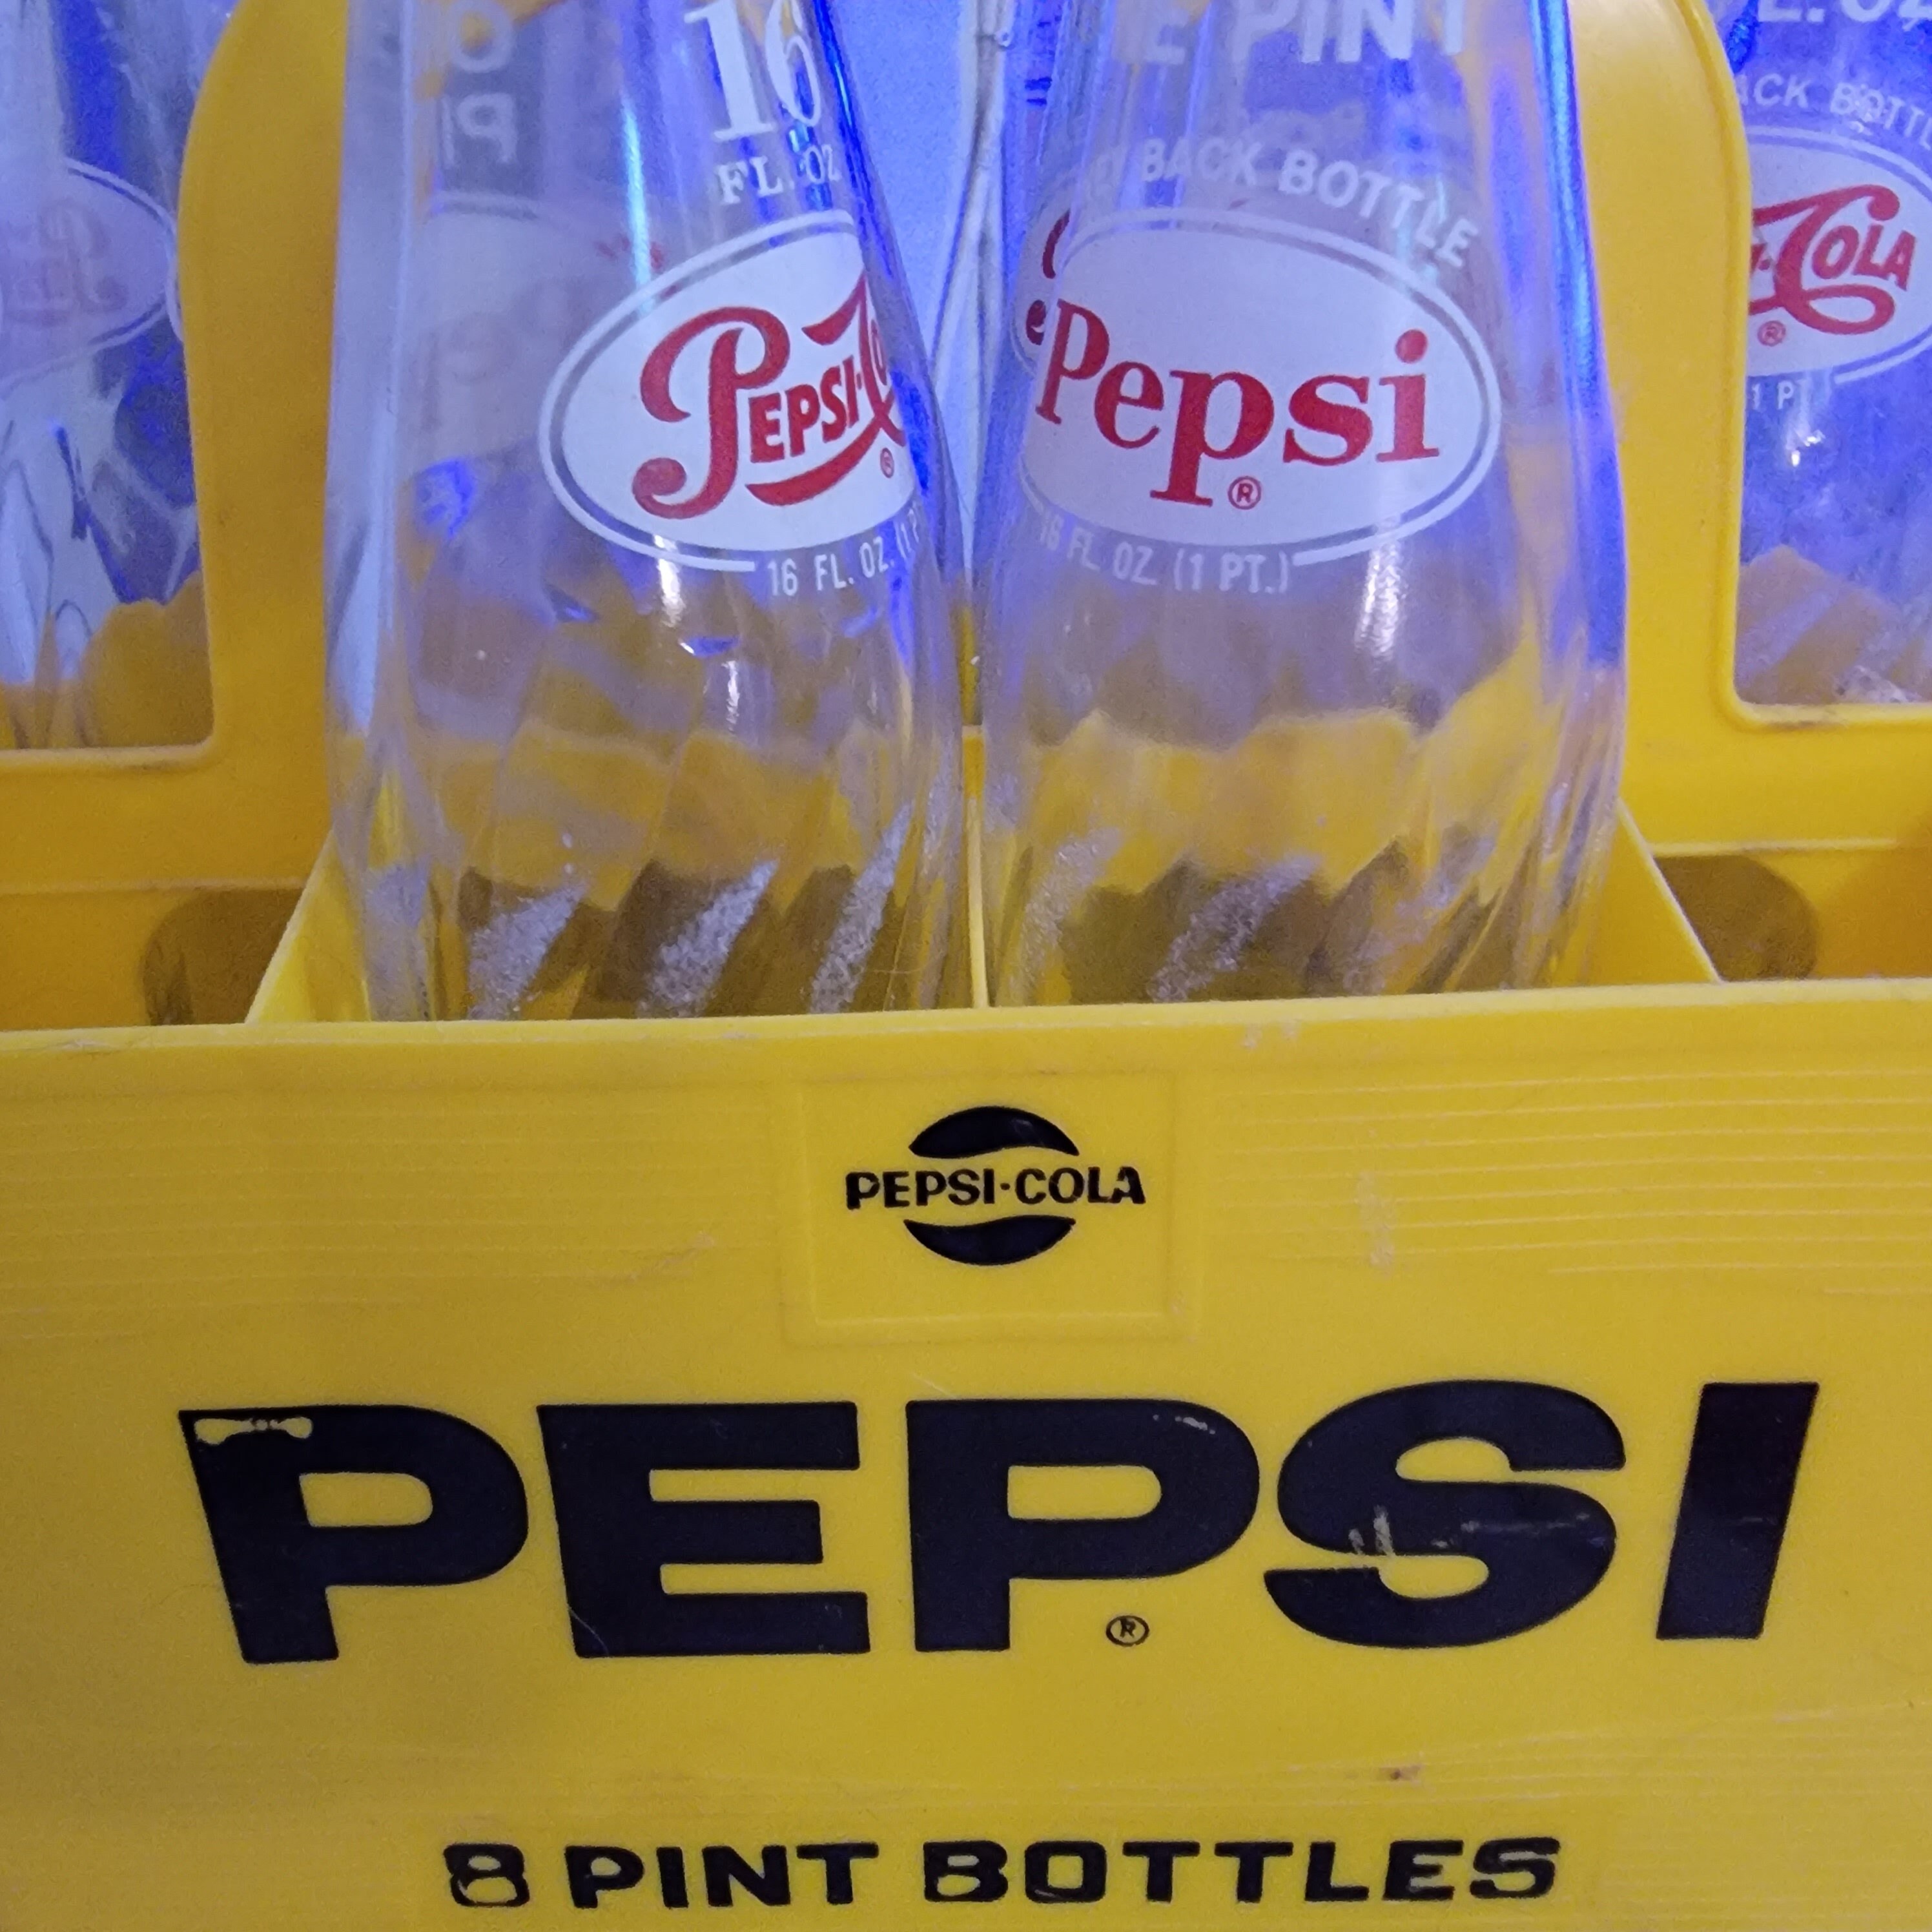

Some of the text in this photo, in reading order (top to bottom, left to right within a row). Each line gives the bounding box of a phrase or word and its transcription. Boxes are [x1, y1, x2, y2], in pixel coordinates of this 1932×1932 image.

[684, 0, 822, 140] 16
[1142, 137, 1262, 189] BACK
[1277, 150, 1479, 268] BOTTLE
[1034, 297, 1441, 508] Pepsi
[768, 557, 798, 597] 16
[814, 552, 854, 591] FL.
[1173, 548, 1205, 593] (1
[1218, 549, 1290, 595] PT.)
[178, 1378, 1820, 1667] PEPSI
[442, 1836, 1561, 1911] 8 PINT BOTTLES
